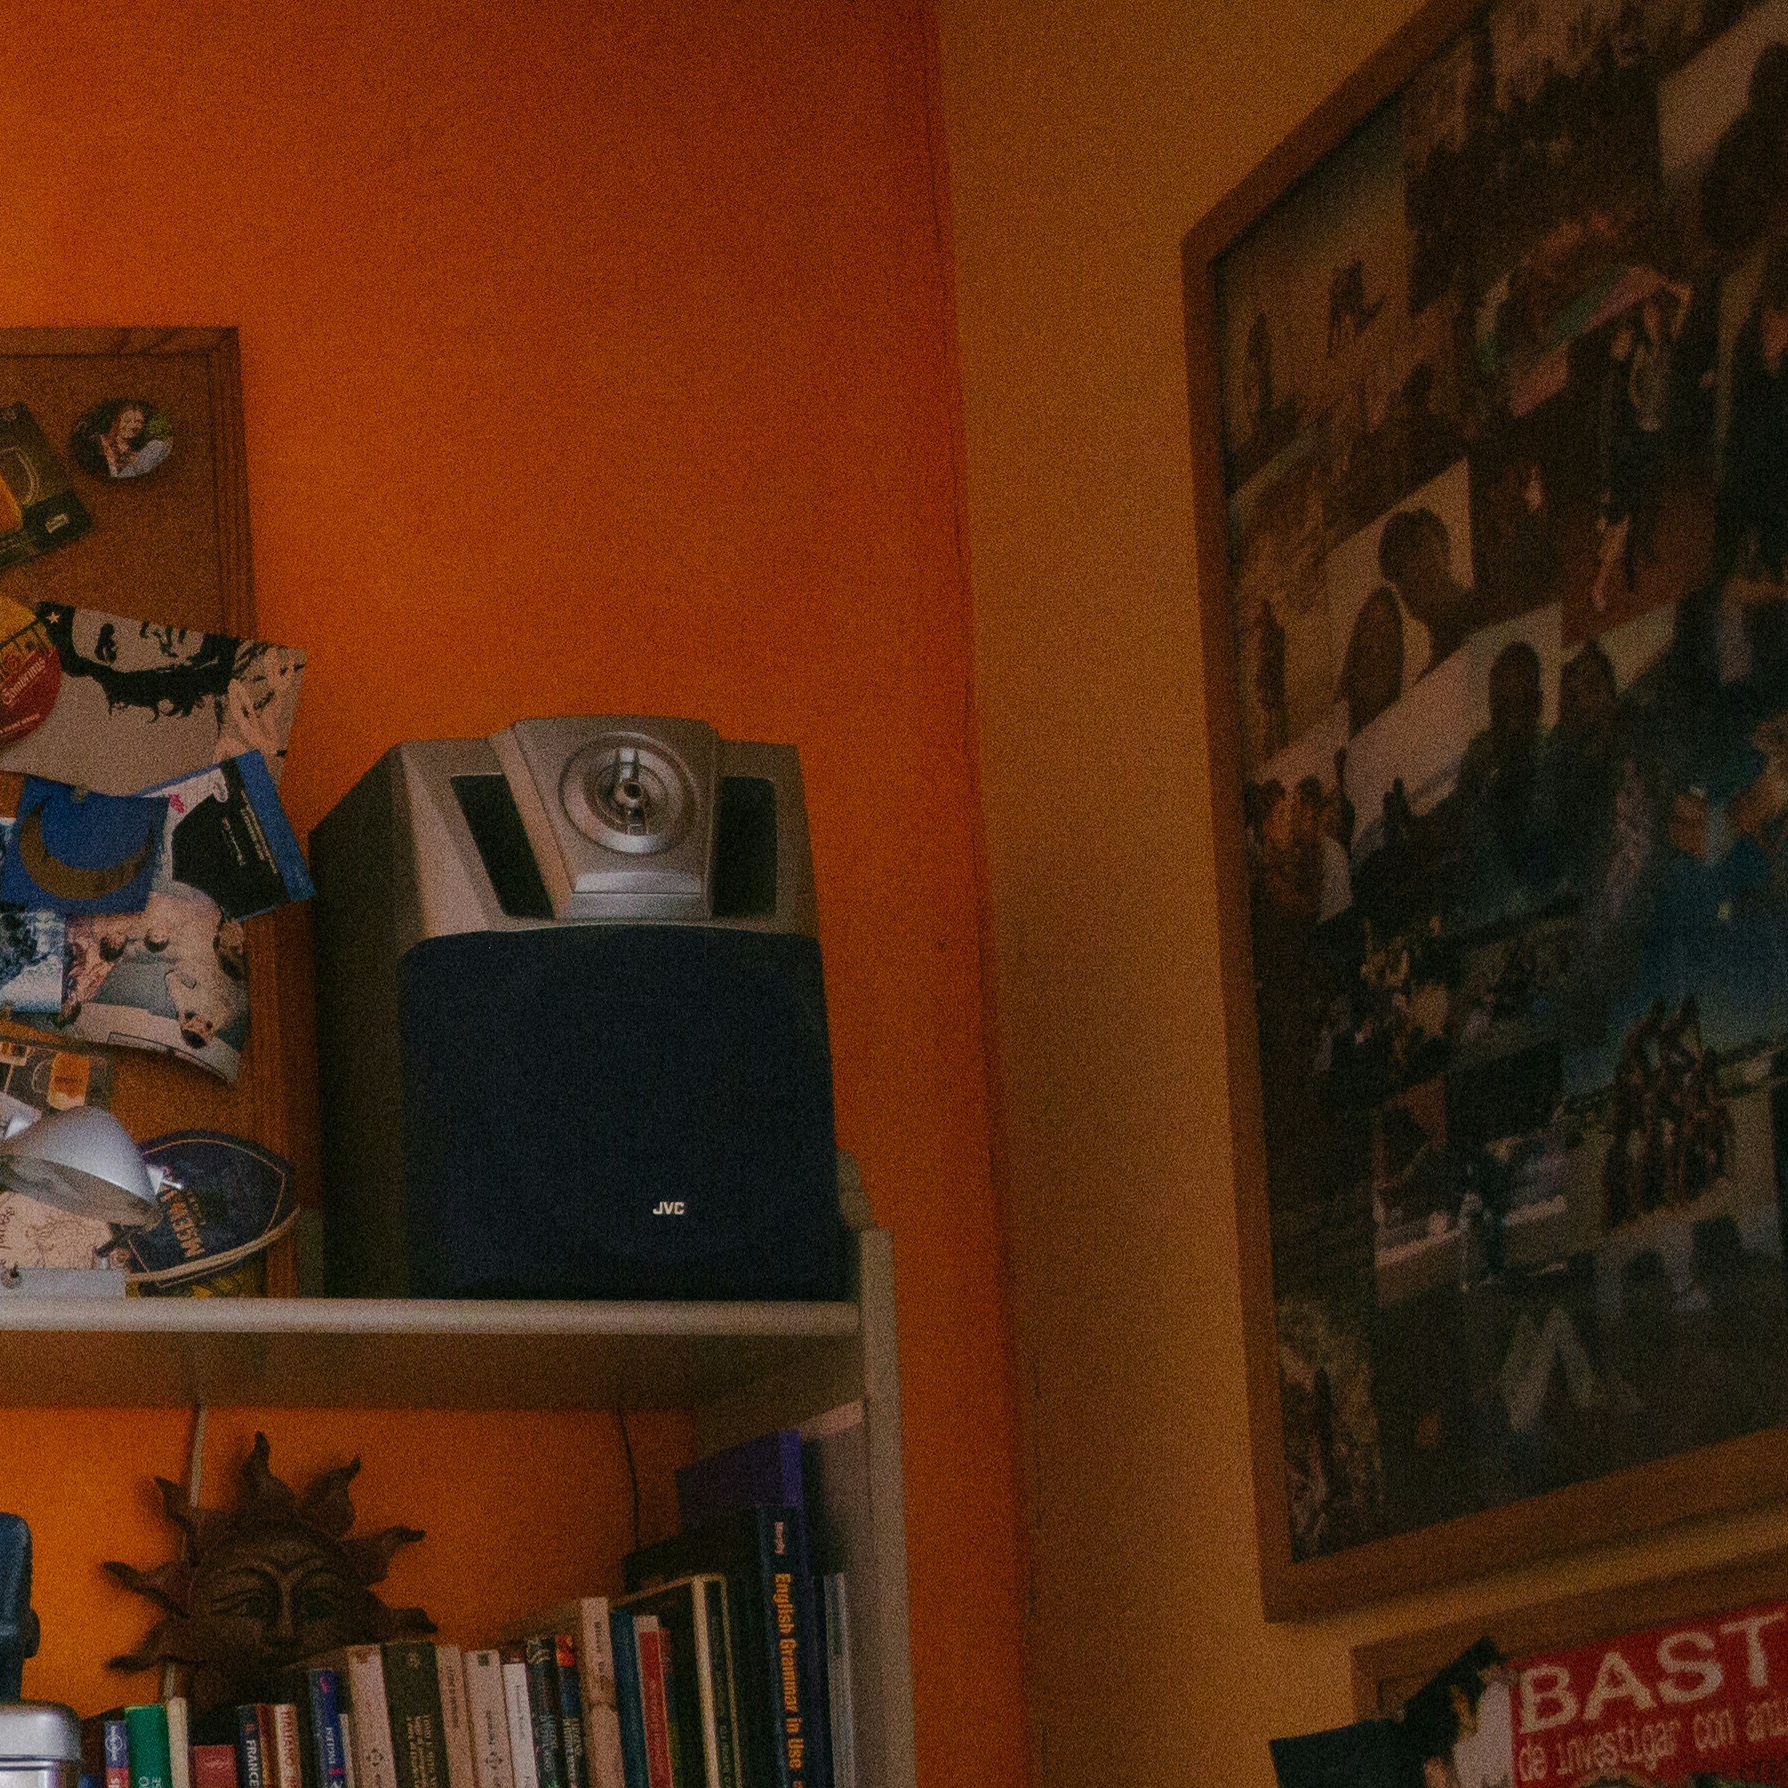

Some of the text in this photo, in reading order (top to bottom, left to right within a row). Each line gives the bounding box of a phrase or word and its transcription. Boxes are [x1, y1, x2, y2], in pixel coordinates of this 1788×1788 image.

[653, 1202, 685, 1215] JVC
[773, 1574, 804, 1770] English Grammar in Use
